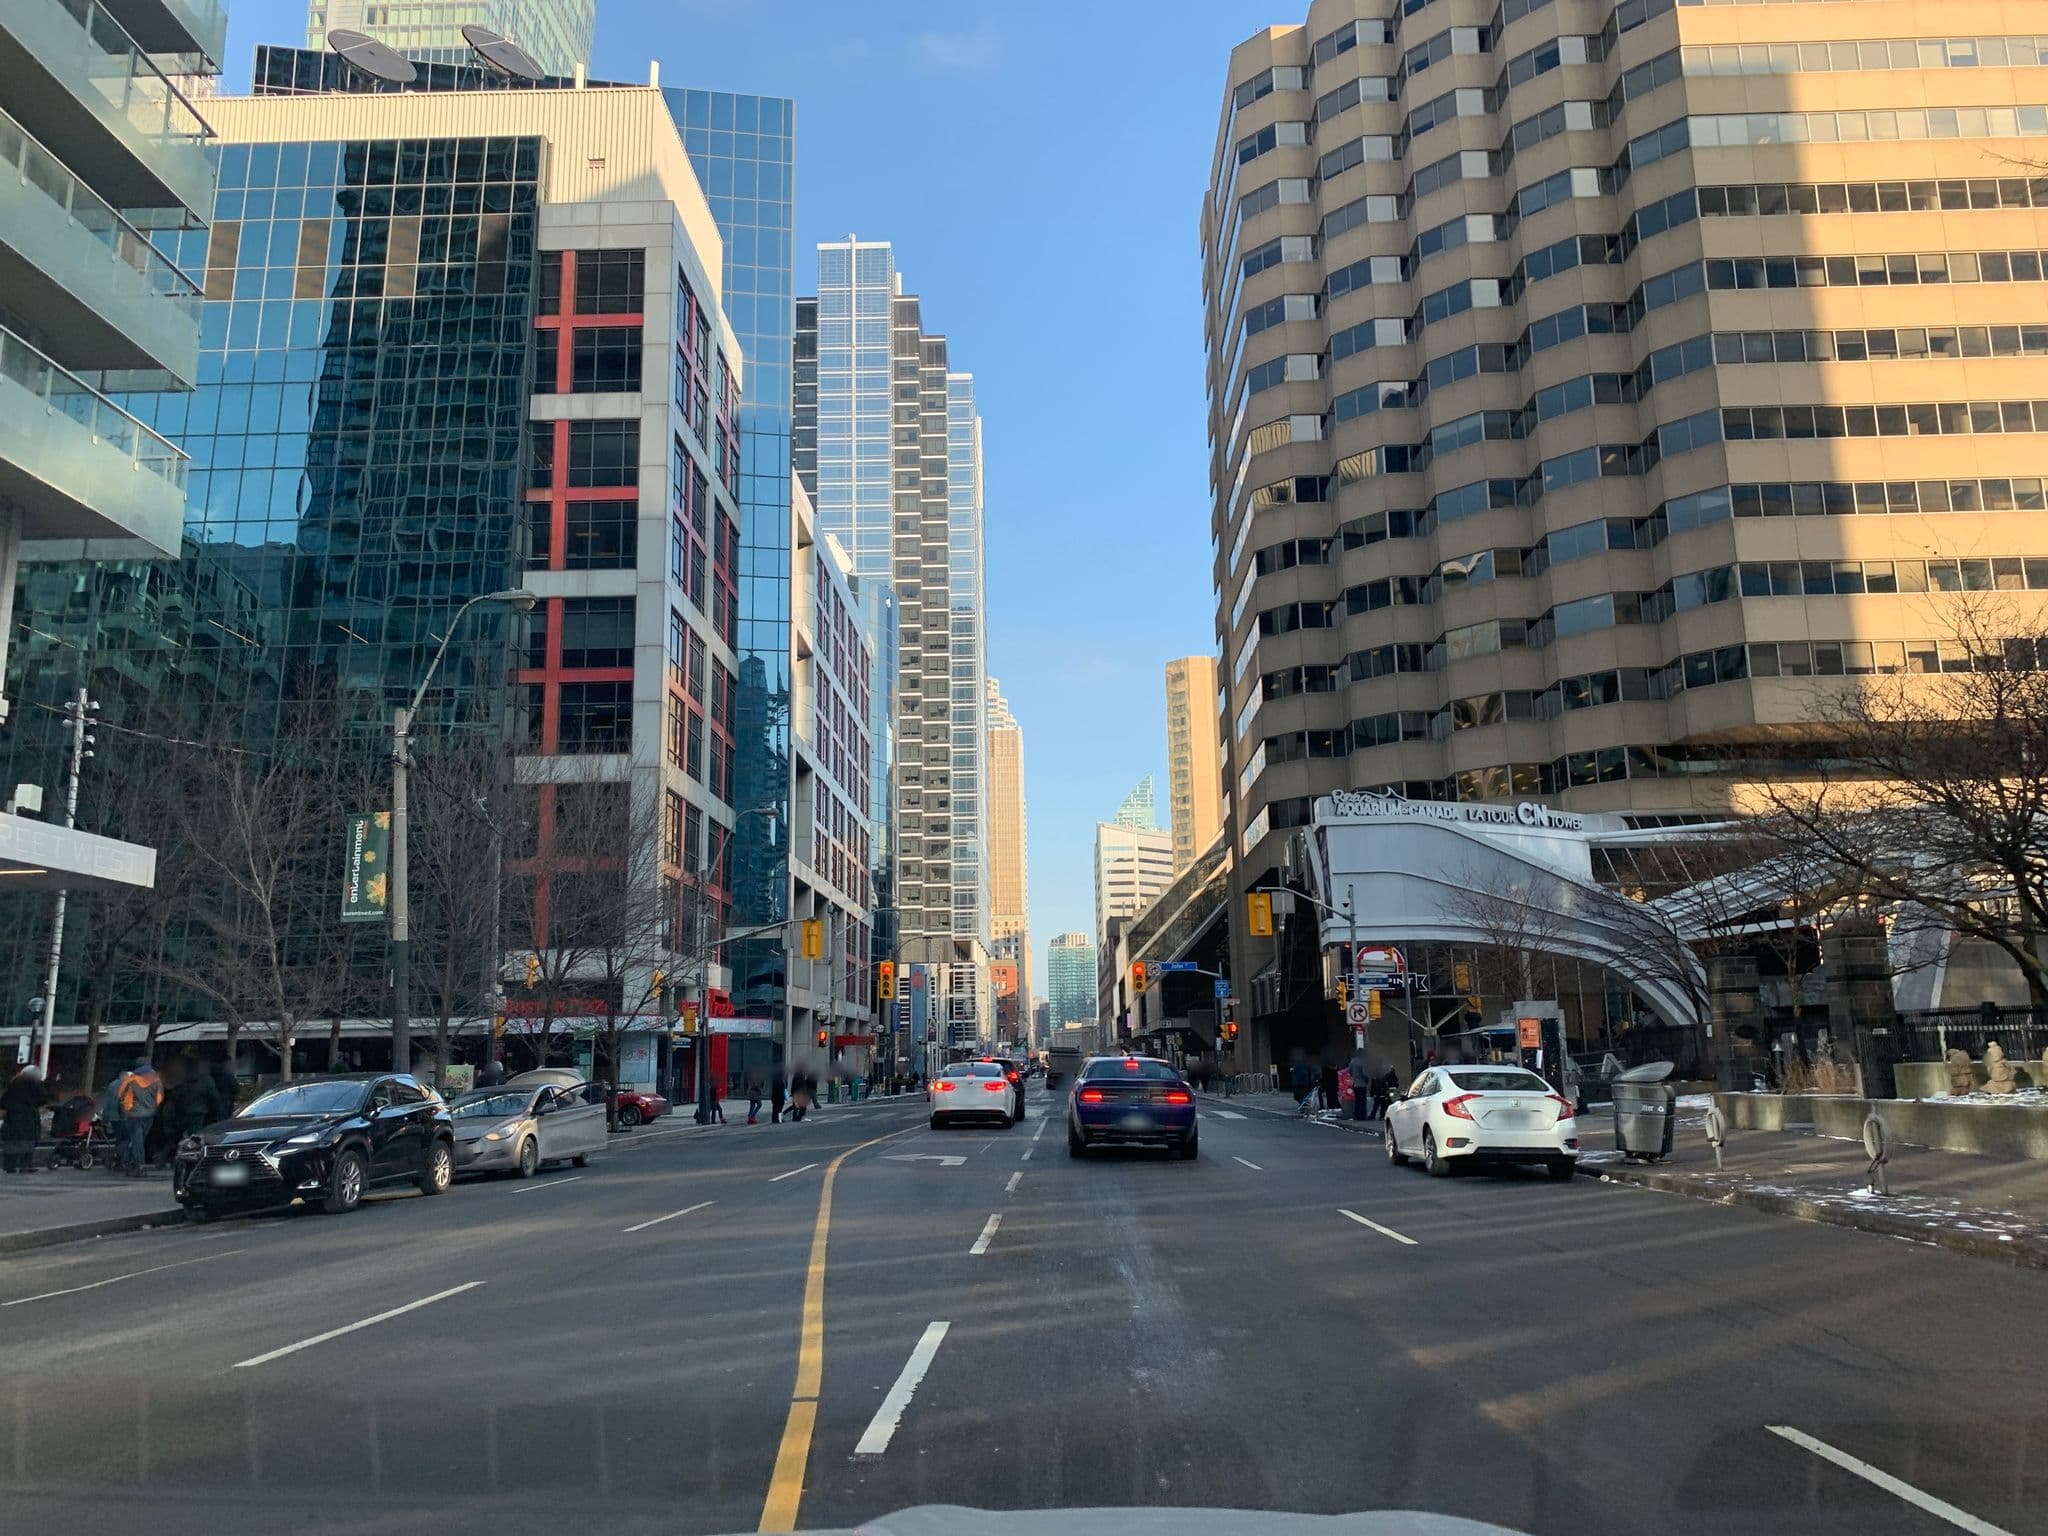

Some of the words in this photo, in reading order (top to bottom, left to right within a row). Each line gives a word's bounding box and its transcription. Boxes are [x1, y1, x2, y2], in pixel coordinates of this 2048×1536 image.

[1336, 801, 1402, 817] AQUARIUM
[1409, 804, 1460, 820] CANADA
[1467, 808, 1484, 822] LA
[1484, 809, 1516, 824] TOUR
[1516, 801, 1550, 827] CN
[1549, 815, 1583, 831] TOWER
[350, 819, 364, 904] entertainment
